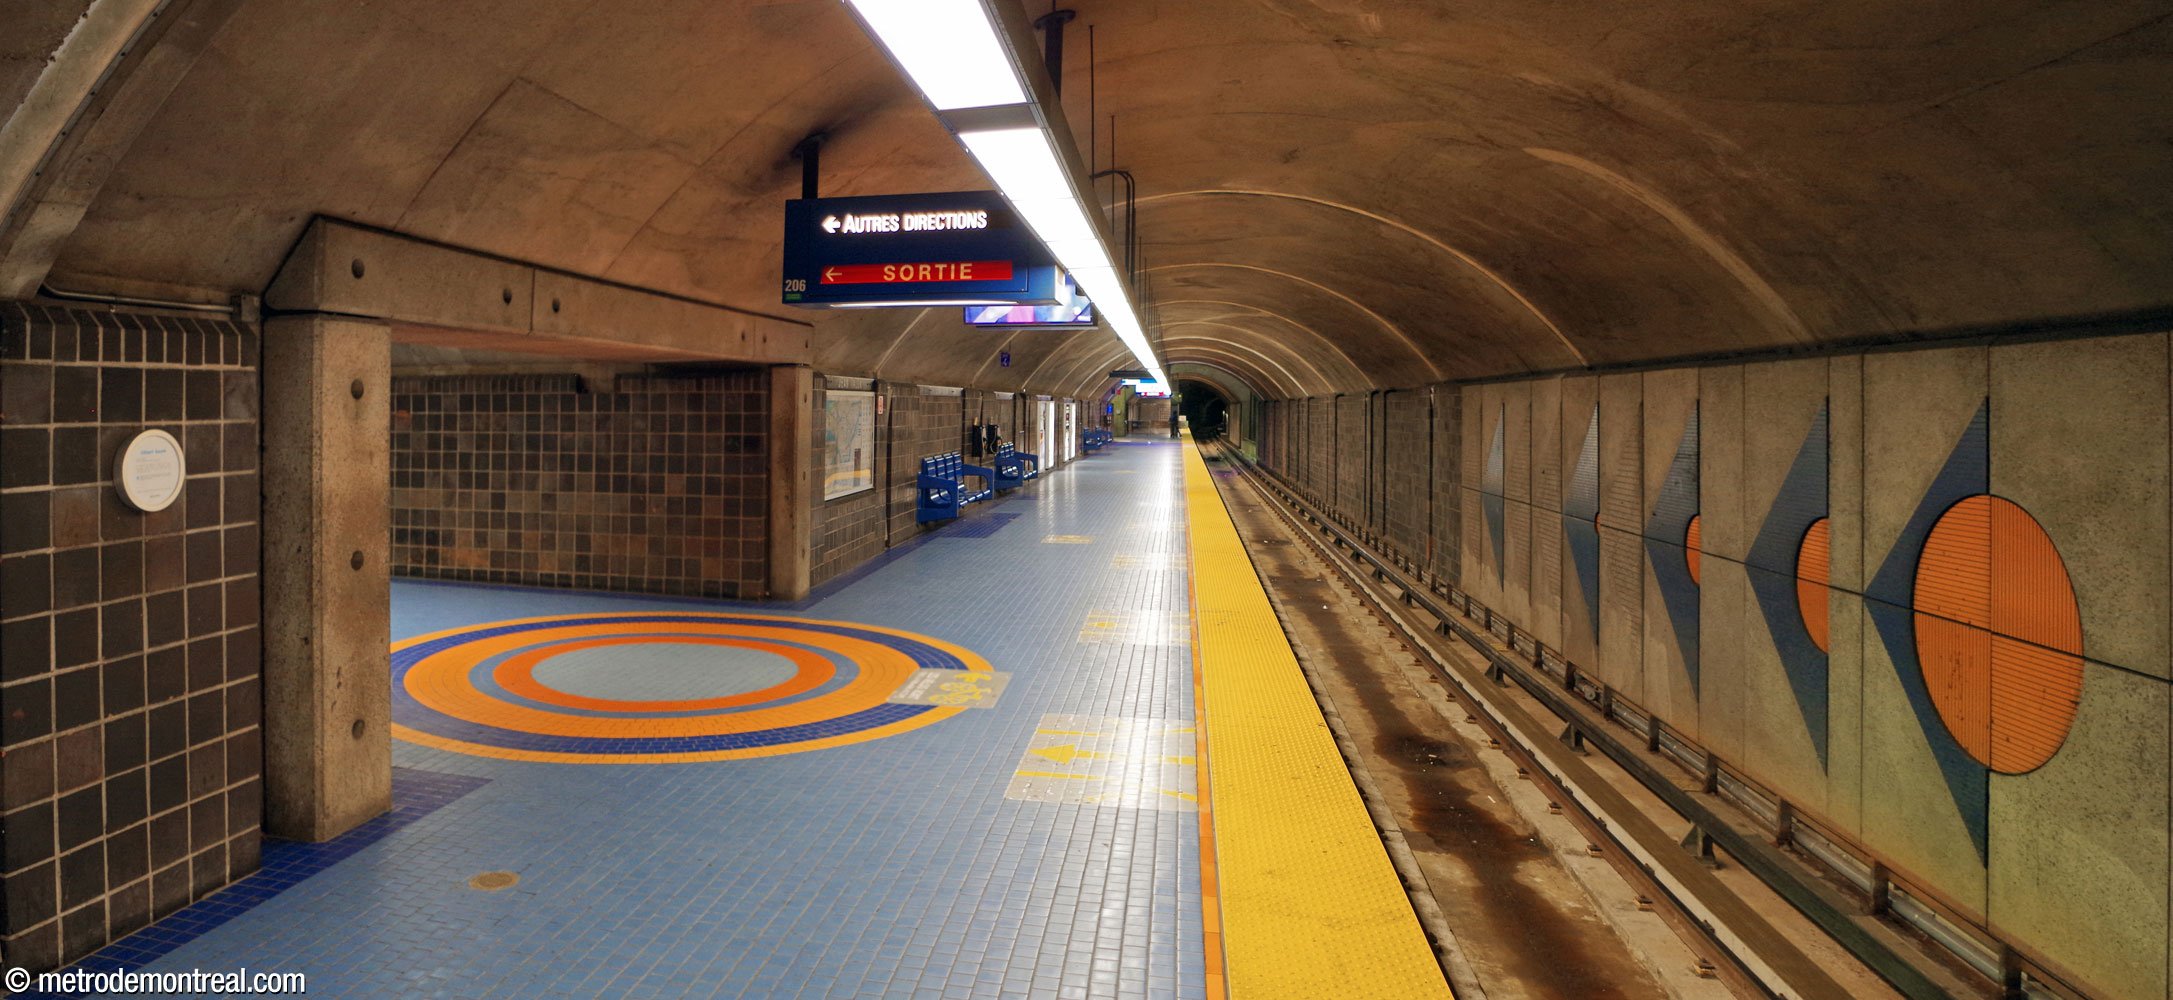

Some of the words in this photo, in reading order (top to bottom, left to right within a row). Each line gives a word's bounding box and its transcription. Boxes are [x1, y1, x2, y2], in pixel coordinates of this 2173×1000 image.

[843, 214, 900, 233] AUTRES
[904, 211, 987, 231] DIRECTIONS
[883, 263, 973, 281] SORTIE
[785, 279, 807, 292] 206
